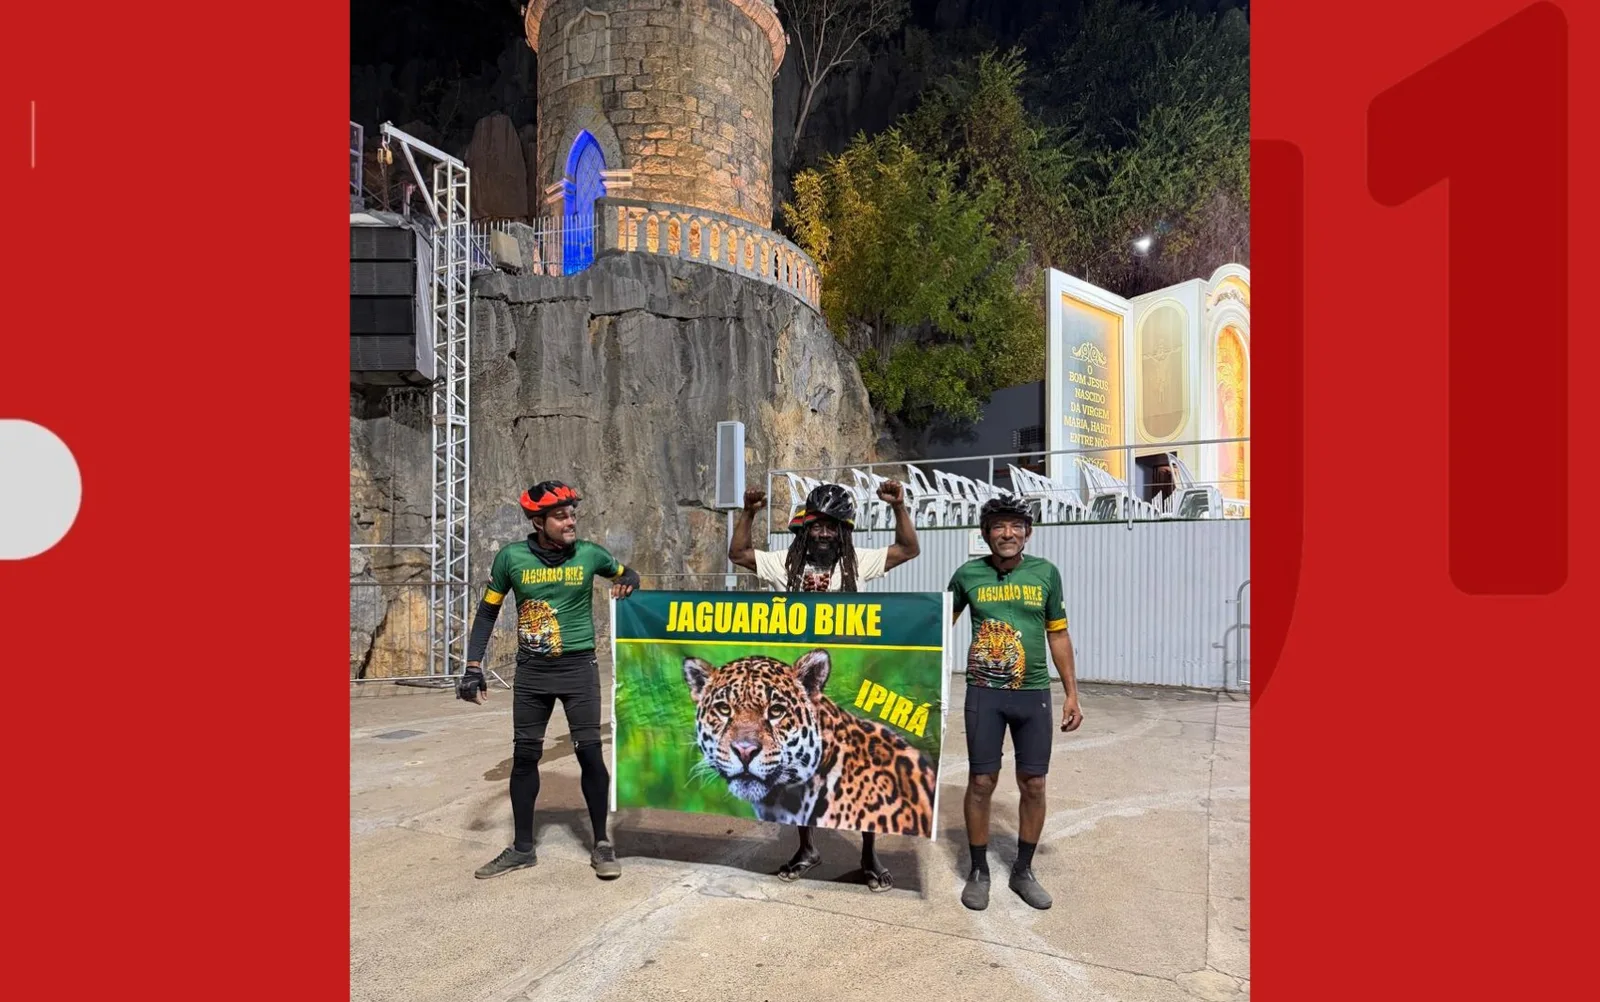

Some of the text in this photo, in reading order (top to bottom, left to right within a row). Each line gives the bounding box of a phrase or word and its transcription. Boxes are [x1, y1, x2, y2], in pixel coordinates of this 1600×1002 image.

[1087, 365, 1093, 375] O
[1069, 371, 1109, 391] BOM JESUS
[1075, 387, 1106, 404] NASCIDO
[1070, 401, 1110, 420] DA VIRGEM
[1063, 415, 1090, 433] MARIA,
[1069, 432, 1094, 447] ENTRE
[565, 565, 584, 581] BIKE
[1022, 585, 1043, 602] BIKE
[666, 597, 882, 637] JAGUARÃO BIKE
[853, 678, 933, 738] IPIRÁ
